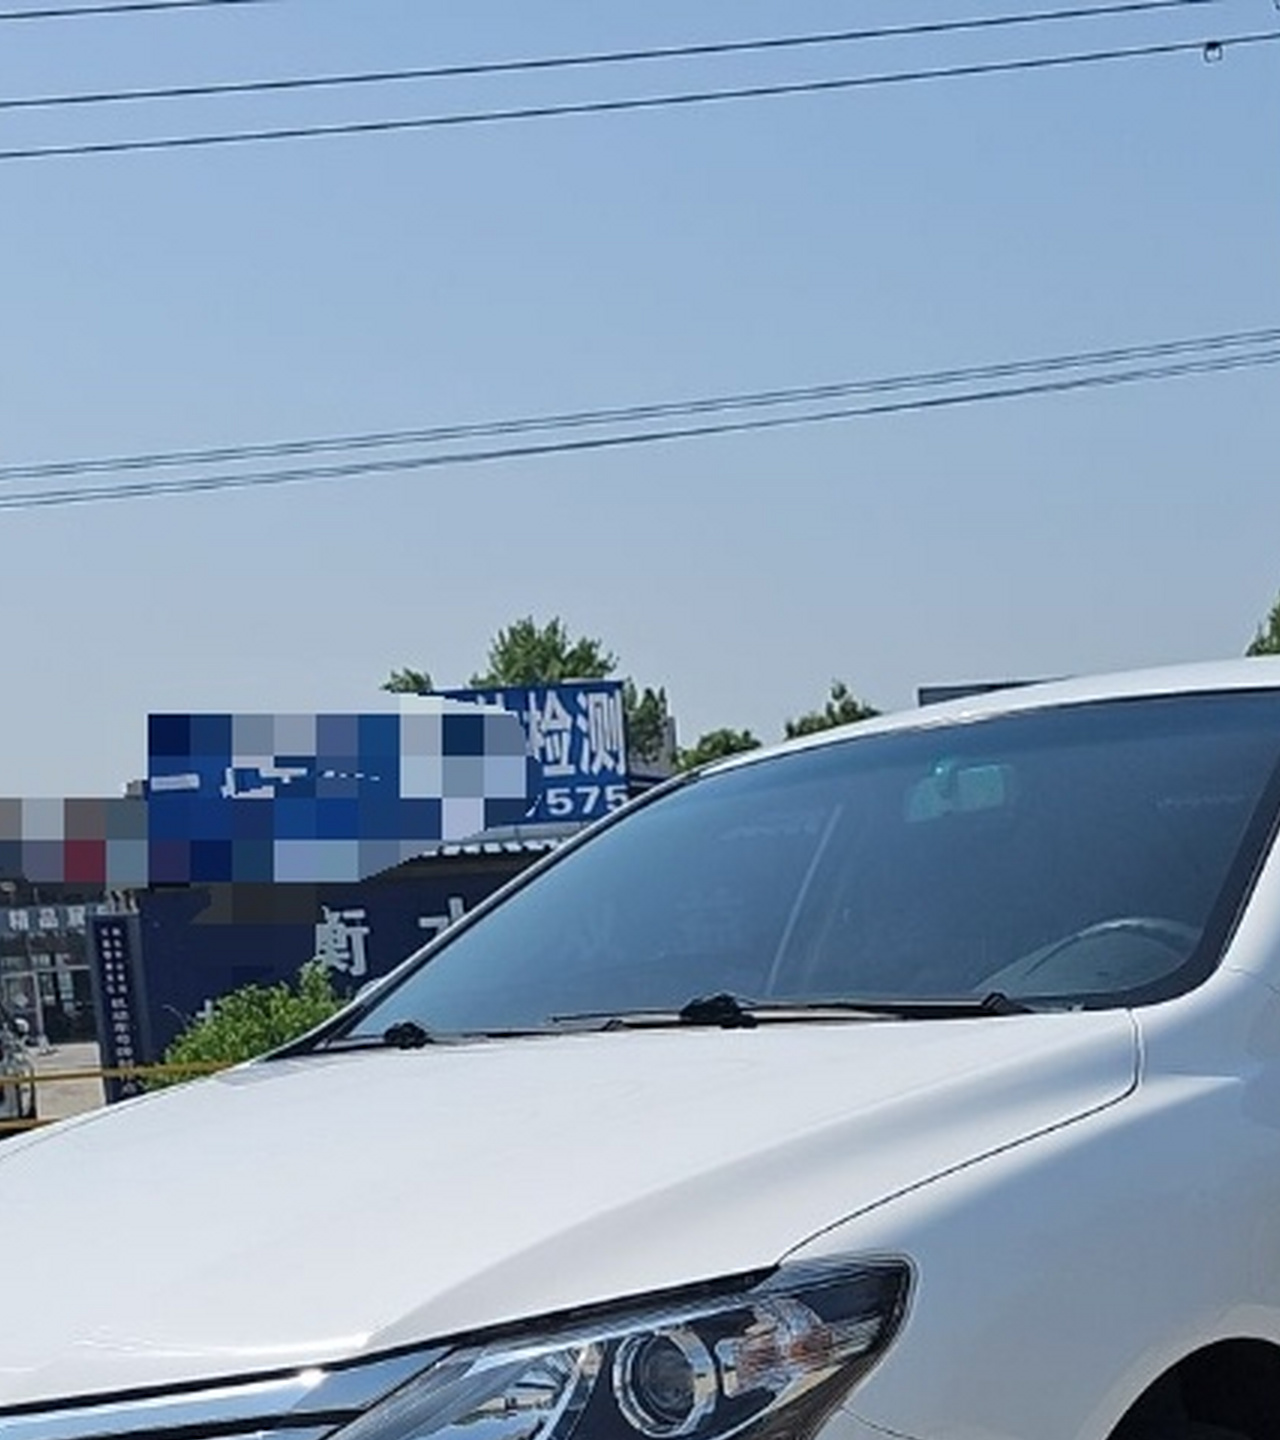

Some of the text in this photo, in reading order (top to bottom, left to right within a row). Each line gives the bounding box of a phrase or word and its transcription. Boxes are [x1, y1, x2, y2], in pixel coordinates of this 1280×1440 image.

[477, 688, 627, 777] 检测
[525, 784, 629, 817] 575
[8, 904, 111, 931] 精品展
